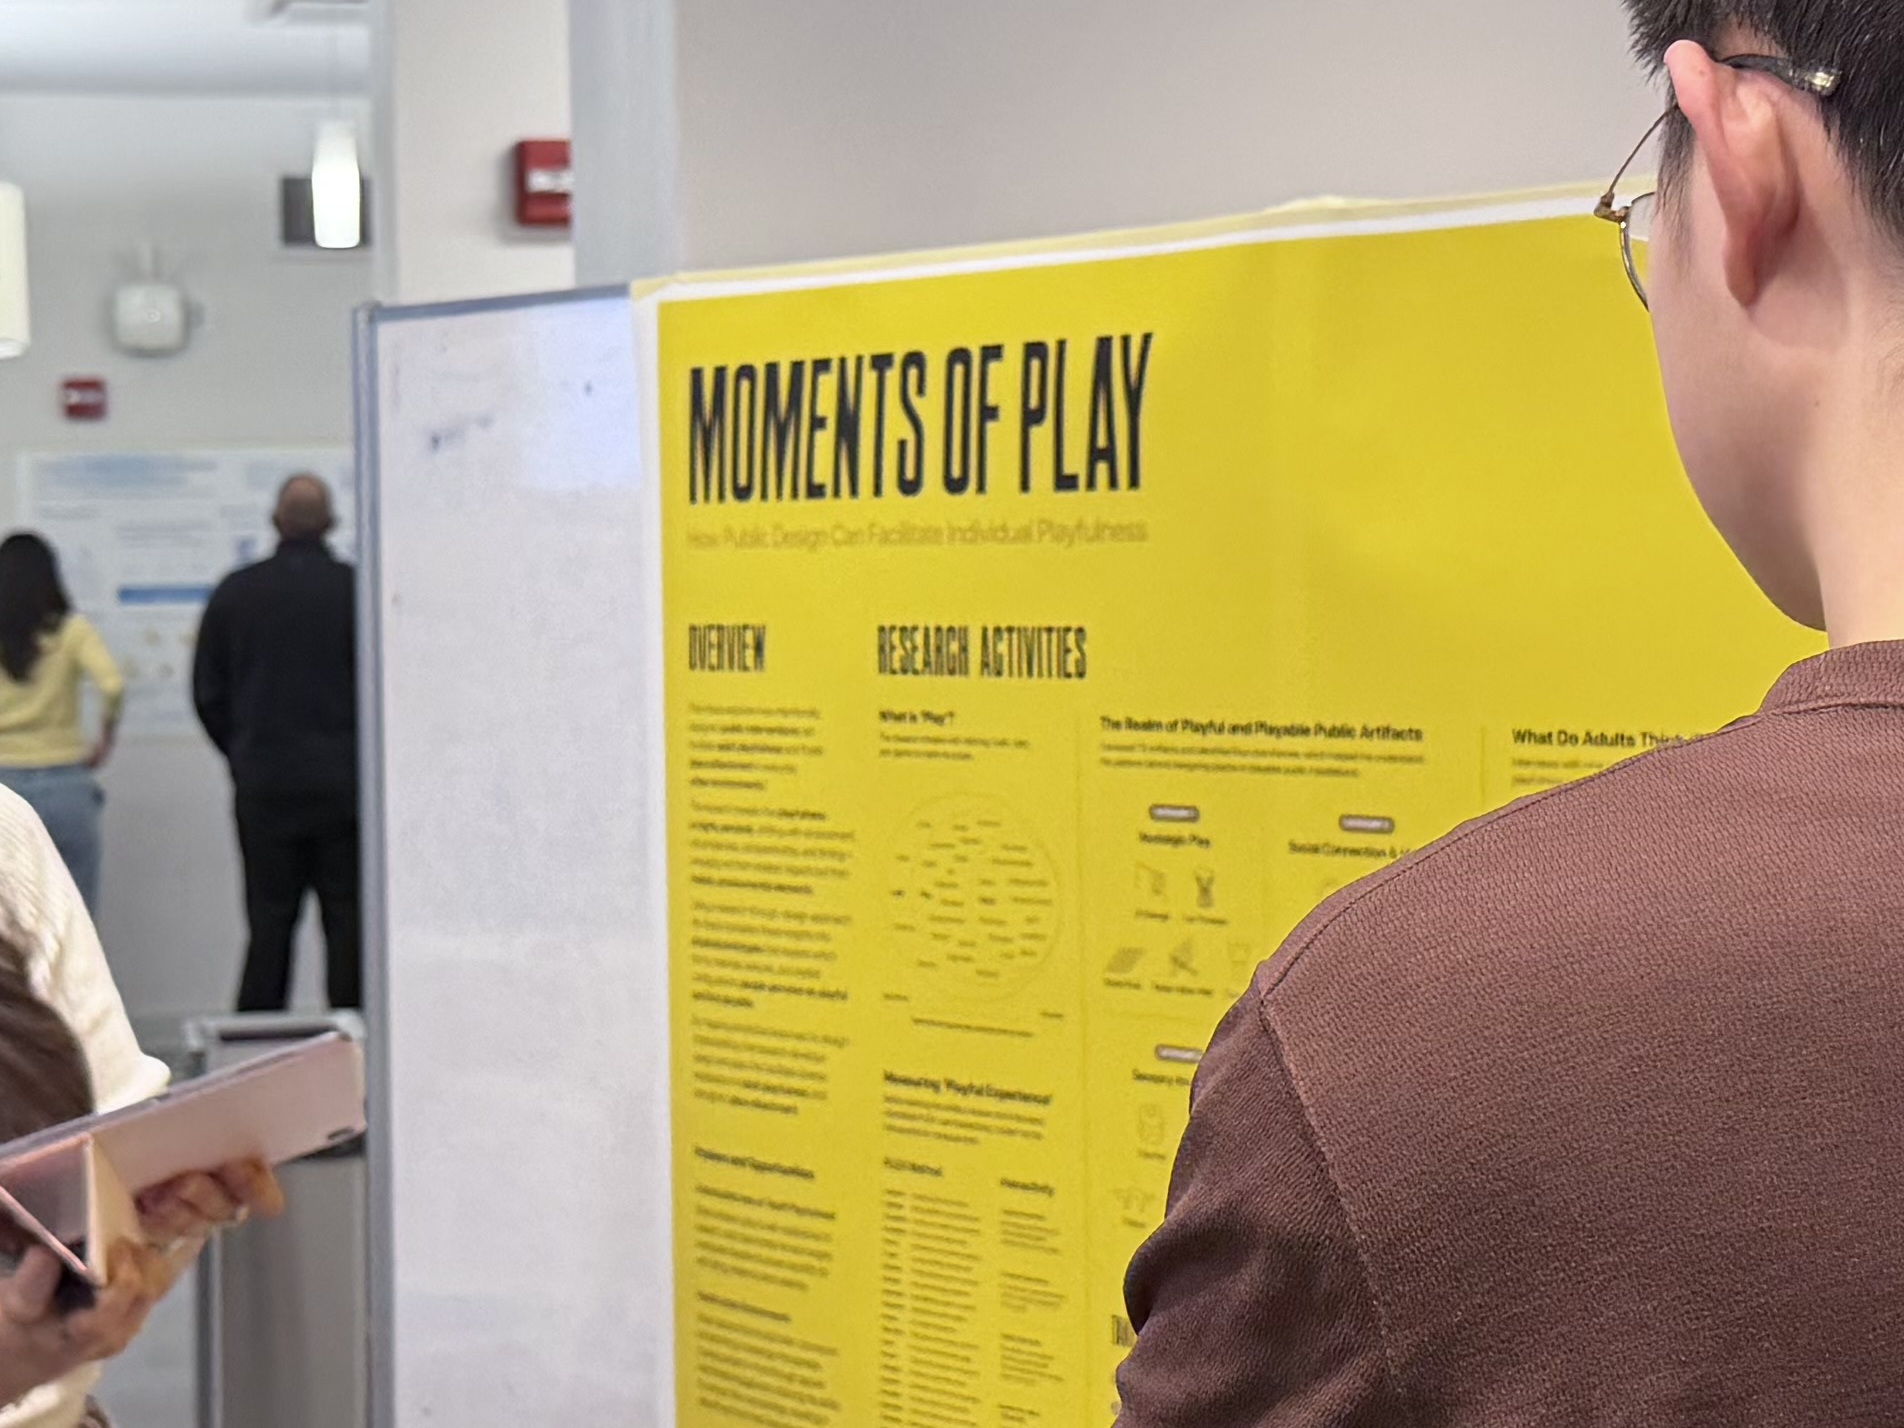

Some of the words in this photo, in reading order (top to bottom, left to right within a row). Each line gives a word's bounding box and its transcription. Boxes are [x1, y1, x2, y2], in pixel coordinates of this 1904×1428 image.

[689, 349, 927, 505] MOMENTS
[942, 342, 1005, 496] OF
[1018, 331, 1154, 494] PLAY
[723, 523, 768, 549] Public
[772, 522, 829, 554] Design
[831, 522, 863, 547] Can
[867, 519, 943, 547] Facilitate
[946, 518, 1034, 545] Individual
[1037, 516, 1149, 549] Playfulness
[688, 624, 767, 673] OVERVIEW
[878, 625, 970, 677] RESEARCH
[980, 625, 1088, 680] ACTIVITIES
[1099, 715, 1123, 733] The
[1125, 716, 1163, 733] Realm
[1165, 718, 1180, 733] of
[1181, 717, 1226, 737] Playful
[1228, 722, 1253, 736] and
[1255, 720, 1312, 740] Playable
[1314, 721, 1357, 740] Public
[1360, 723, 1424, 743] Artifacts
[1511, 728, 1554, 745] What
[1556, 729, 1580, 746] Do
[1582, 730, 1637, 747] Adults
